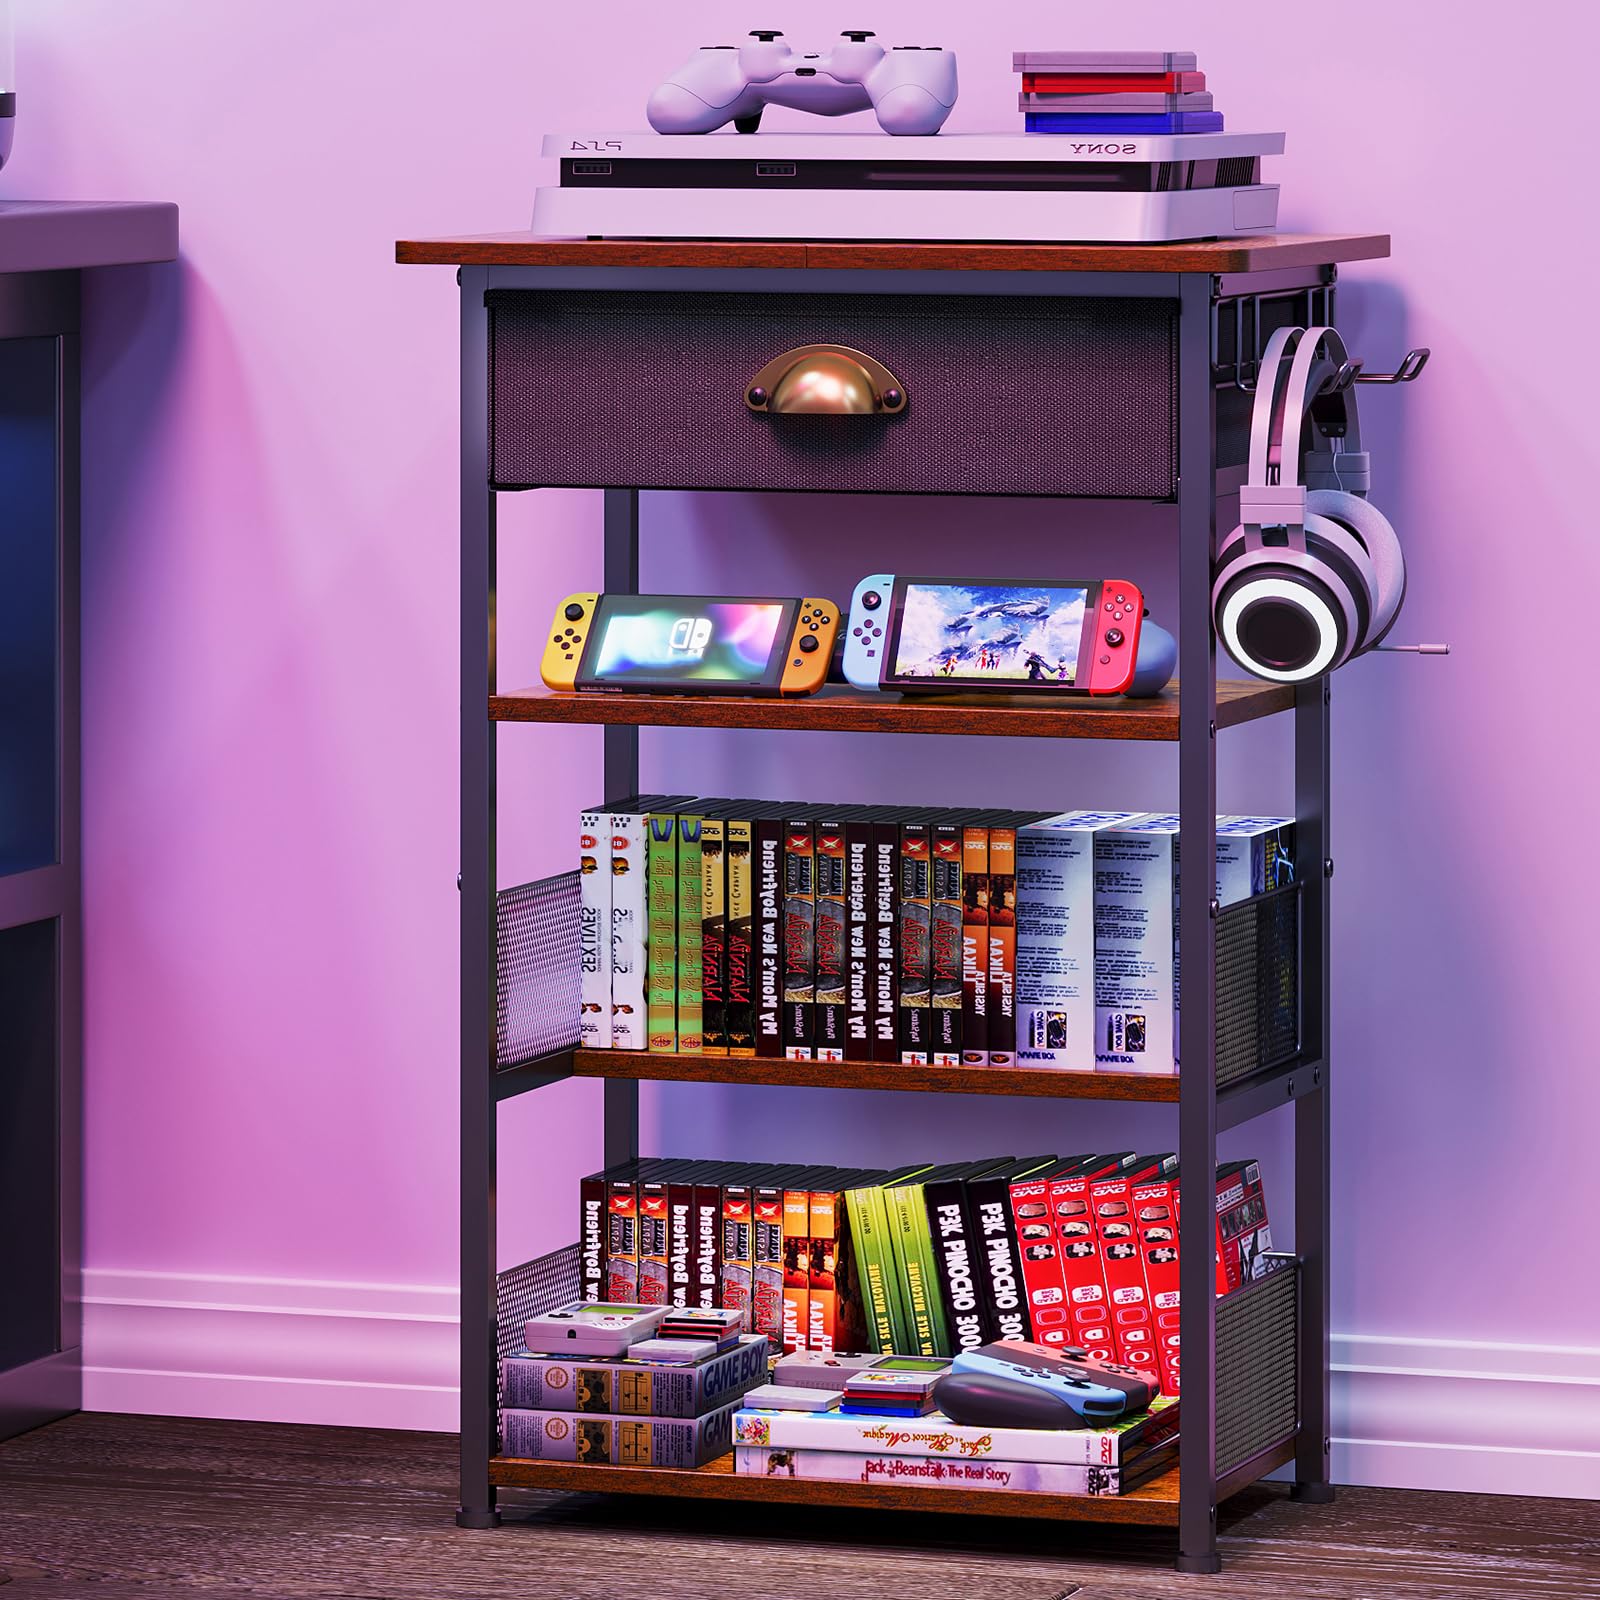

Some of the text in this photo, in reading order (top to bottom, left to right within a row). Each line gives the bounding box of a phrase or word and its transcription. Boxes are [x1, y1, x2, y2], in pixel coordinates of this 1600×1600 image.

[1012, 1187, 1046, 1198] DVD
[1052, 1185, 1085, 1196] DVD
[1093, 1186, 1126, 1197] DVD
[1134, 1190, 1168, 1201] DVD
[937, 1204, 962, 1237] P3K
[980, 1202, 1007, 1235] P3K
[942, 1240, 976, 1311] PINOCHO
[986, 1238, 1018, 1309] PINOCHO
[1036, 1296, 1060, 1304] READ
[1076, 1293, 1100, 1301] READ
[1118, 1295, 1141, 1303] READ
[878, 1317, 891, 1339] SKLE
[917, 1316, 930, 1338] SKLE
[922, 1342, 933, 1355] NA
[704, 1355, 740, 1398] GAME
[741, 1342, 766, 1382] BOY
[862, 1425, 991, 1456] Jack Haricot Magique
[1101, 1436, 1112, 1464] DVD
[861, 1459, 886, 1482] Jack
[947, 1465, 964, 1478] The
[964, 1466, 984, 1479] Real
[985, 1469, 1011, 1486] Story
